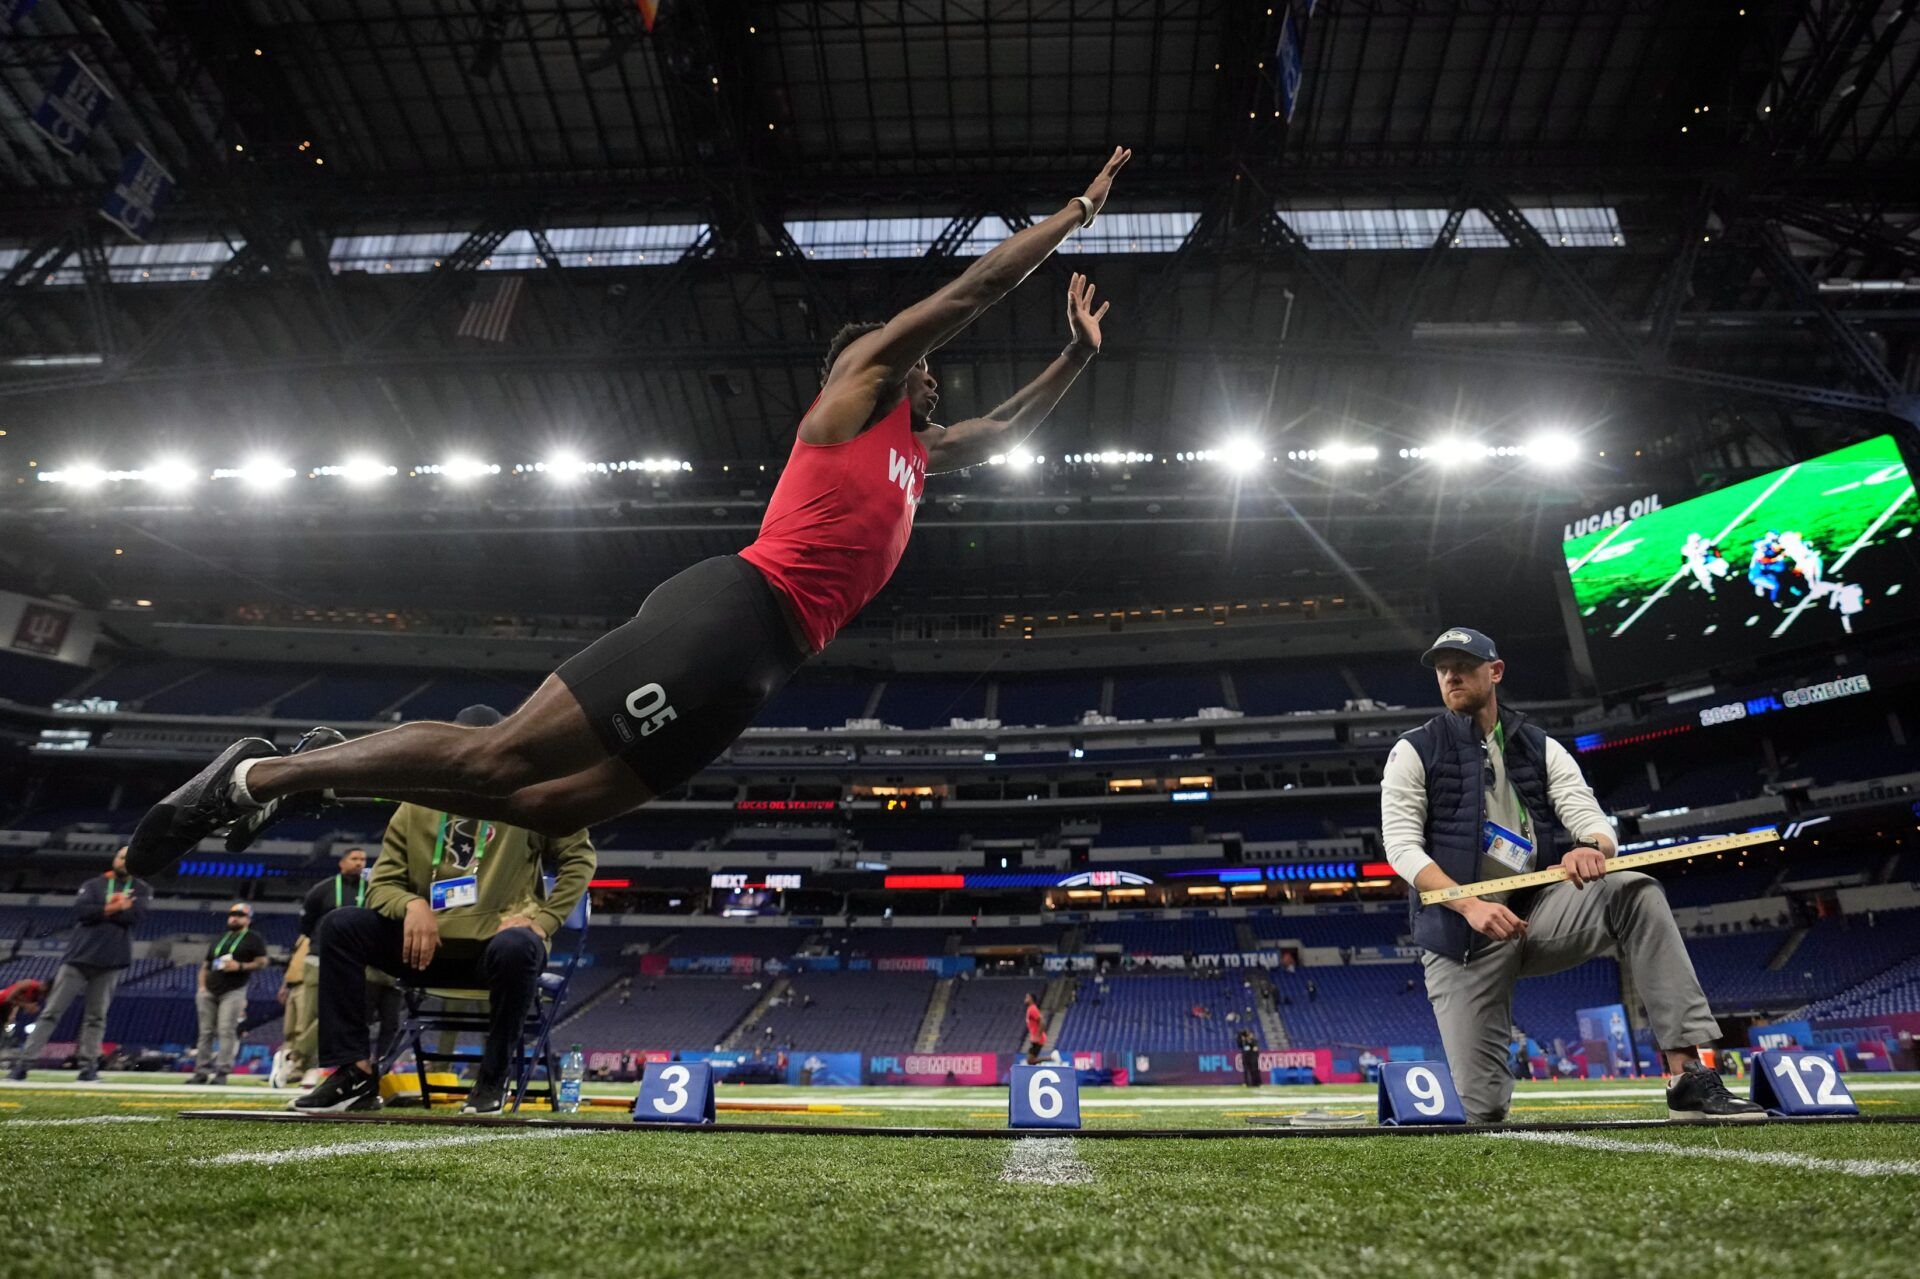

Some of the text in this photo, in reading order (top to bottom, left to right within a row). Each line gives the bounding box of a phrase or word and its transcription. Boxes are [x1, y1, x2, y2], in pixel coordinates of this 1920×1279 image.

[1563, 493, 1662, 541] LUCAS OIL
[626, 682, 677, 737] 05
[1782, 674, 1871, 708] COMBINE
[737, 800, 835, 810] LUCAS OIL STADIUM
[711, 874, 748, 889] NEXT
[1222, 954, 1241, 968] TO
[870, 1055, 982, 1075] NFL COMBINE
[1199, 1051, 1317, 1073] NFL CMBINE
[1773, 1055, 1854, 1105] 12
[653, 1065, 690, 1114] 3
[1028, 1069, 1063, 1119] 6
[1405, 1066, 1445, 1116] 9
